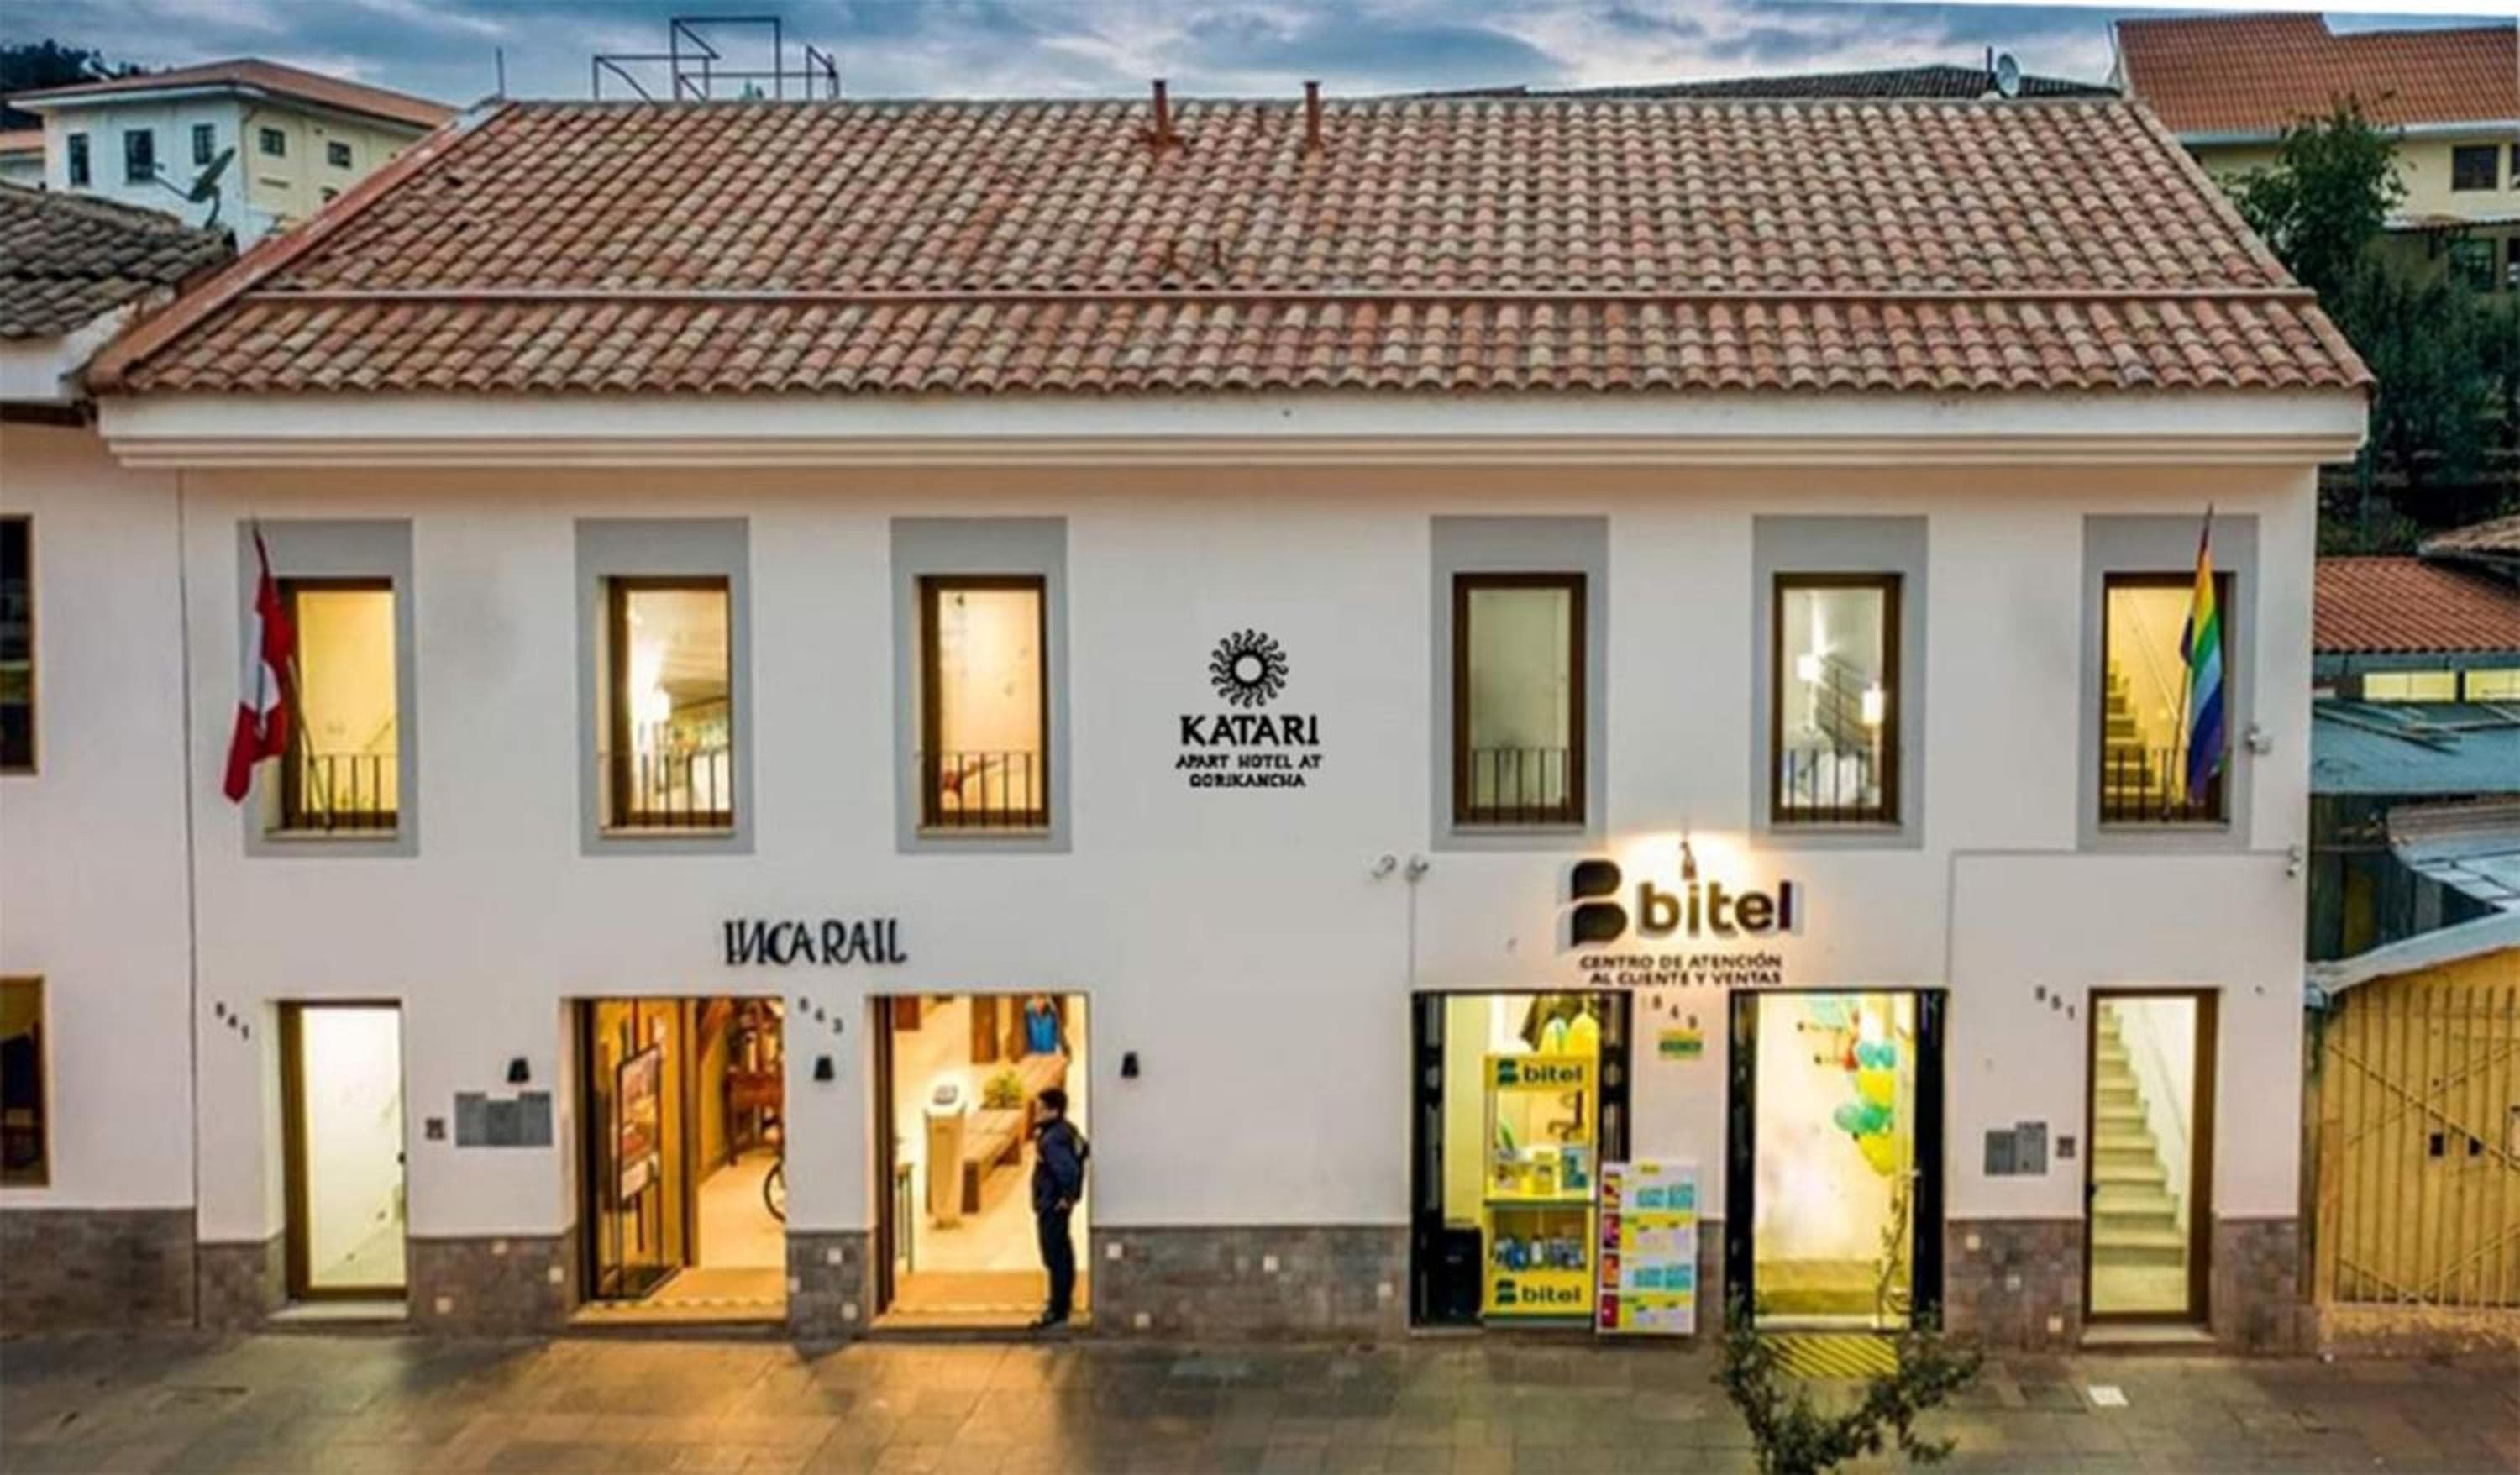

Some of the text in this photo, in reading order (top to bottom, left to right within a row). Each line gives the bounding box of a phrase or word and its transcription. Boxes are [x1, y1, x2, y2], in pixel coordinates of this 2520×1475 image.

[1179, 715, 1320, 747] KATARI
[1175, 754, 1323, 769] APART HOTEL AT
[1640, 881, 1792, 933] bitel
[724, 919, 907, 965] INCA RAIL
[1579, 951, 1782, 969] CENTRO DE ATENCIÓN
[1589, 971, 1782, 985] AL CLIENTE Y VENTAS
[1524, 1065, 1583, 1083] bitel
[1521, 1286, 1582, 1303] bitel
